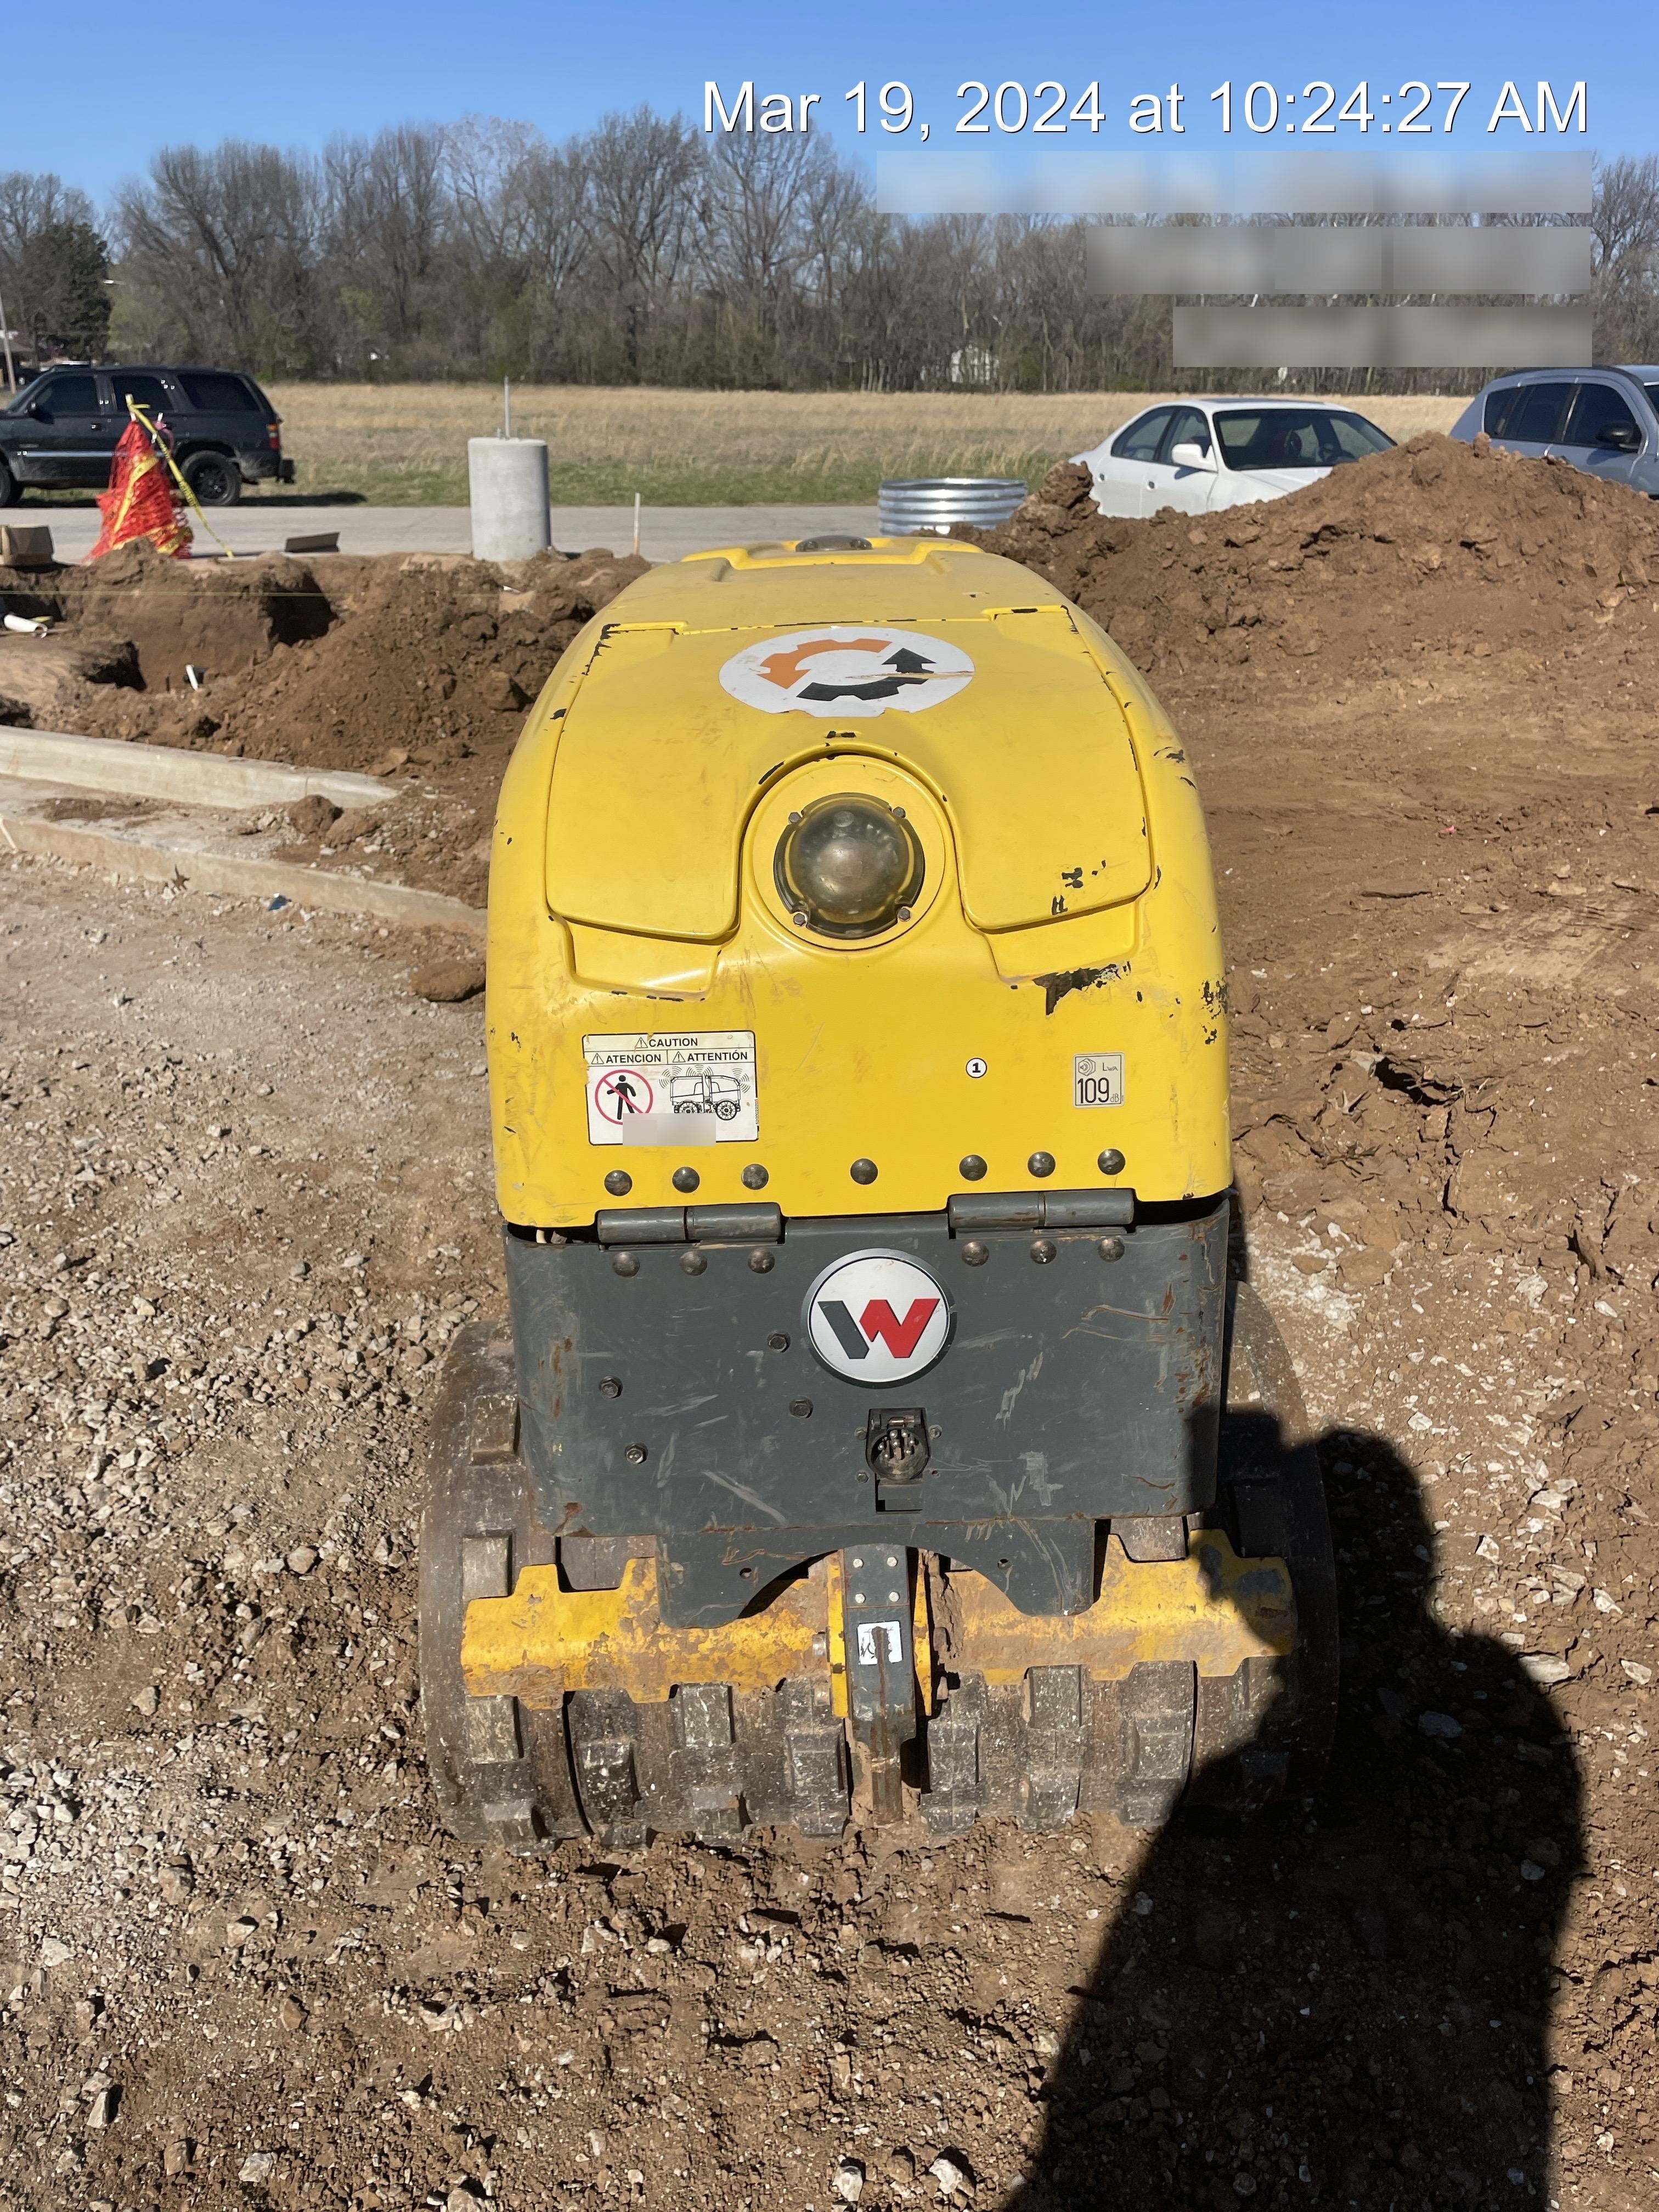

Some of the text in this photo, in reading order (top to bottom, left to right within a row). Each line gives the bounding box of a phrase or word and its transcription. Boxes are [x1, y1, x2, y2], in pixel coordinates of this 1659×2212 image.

[648, 1037, 698, 1047] CAUTION
[606, 1054, 662, 1064] ATENCION
[687, 1049, 748, 1062] ATTENTIÓN
[972, 1062, 981, 1074] 1
[1077, 1077, 1109, 1104] 109
[1110, 1093, 1120, 1103] dB
[817, 1298, 941, 1359] W
